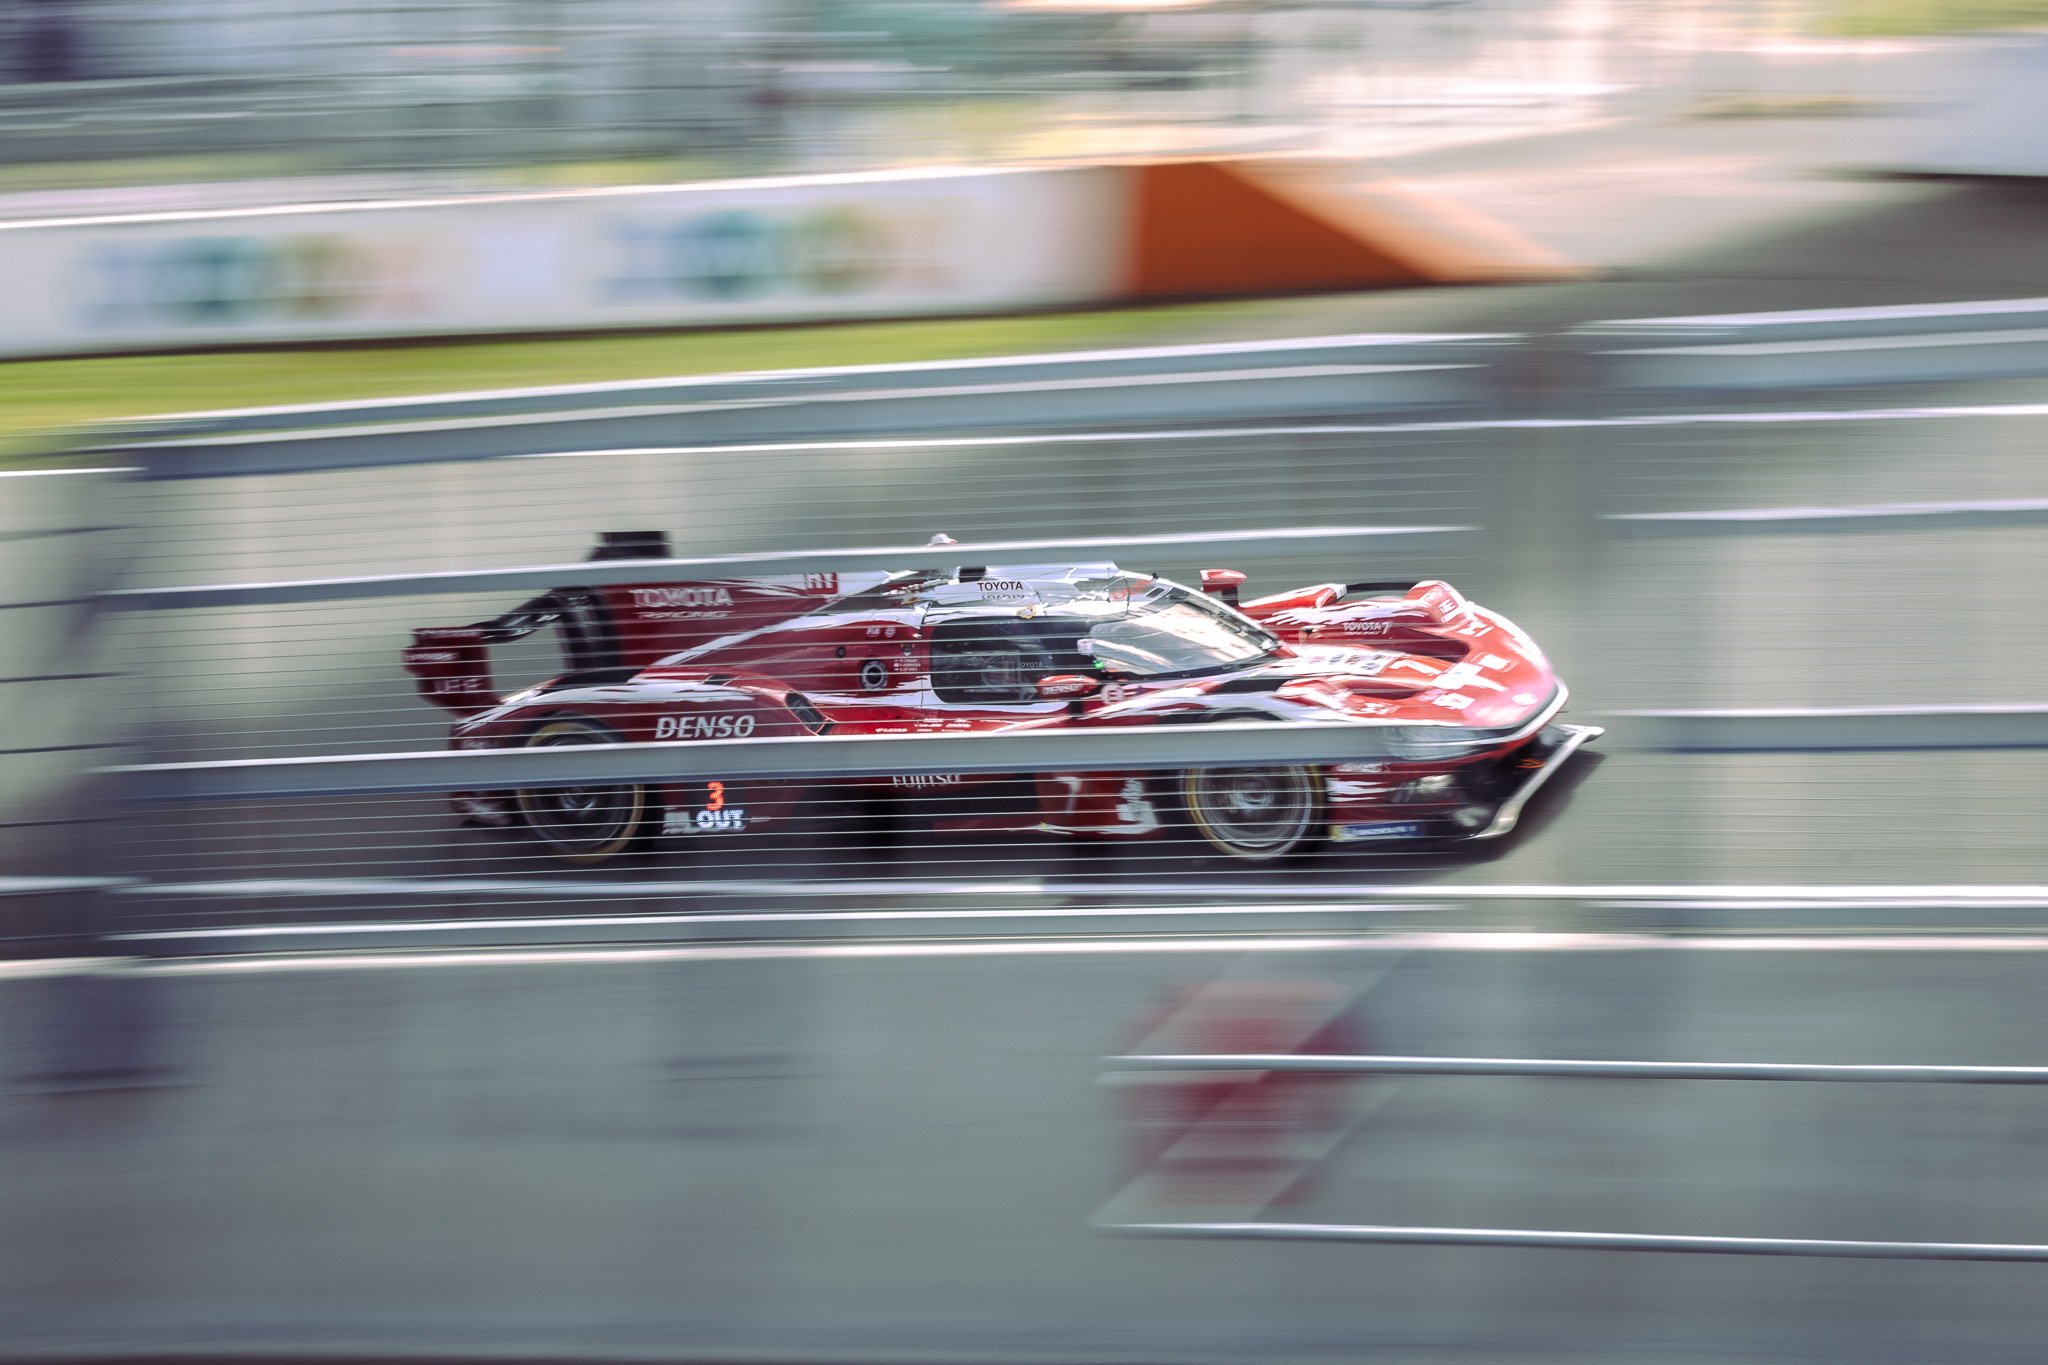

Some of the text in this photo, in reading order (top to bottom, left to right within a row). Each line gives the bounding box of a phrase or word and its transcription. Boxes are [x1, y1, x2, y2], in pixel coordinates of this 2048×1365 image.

[977, 581, 1023, 591] TOYOTA
[629, 587, 735, 607] TOYOTA
[1342, 622, 1381, 631] TOYOTA
[655, 714, 756, 739] DENSO
[706, 781, 724, 811] 3
[696, 810, 744, 829] OUT
